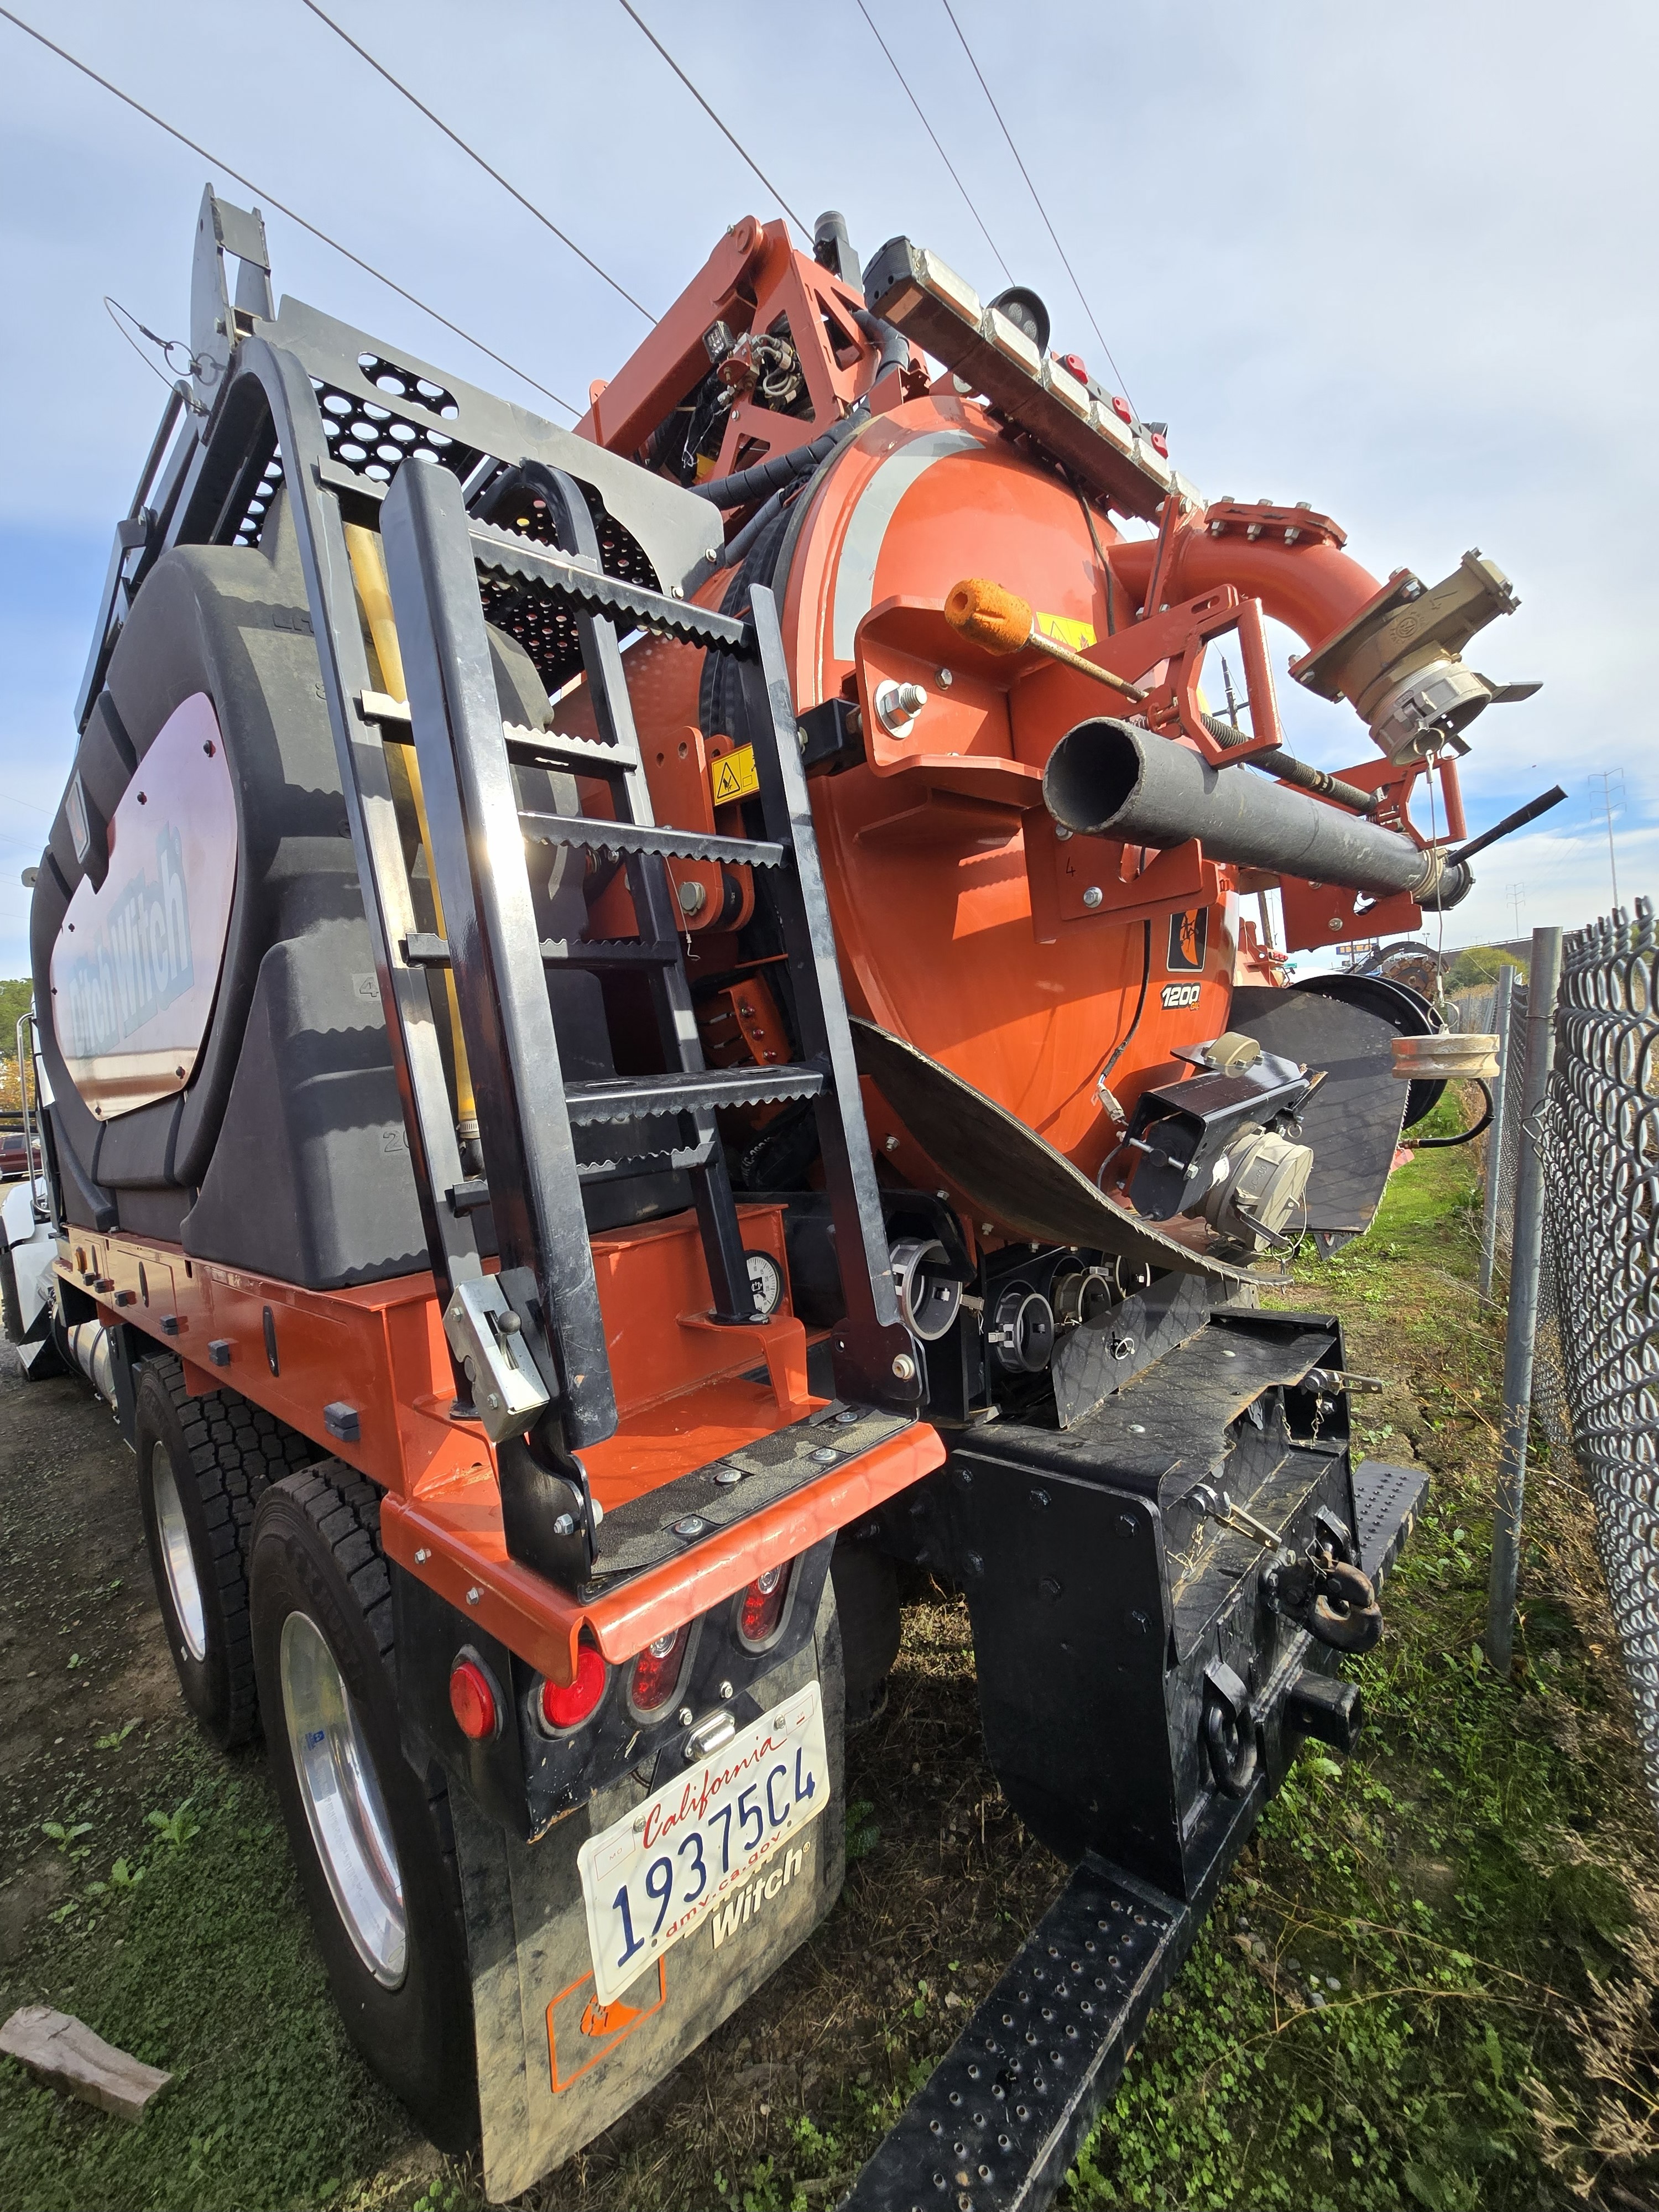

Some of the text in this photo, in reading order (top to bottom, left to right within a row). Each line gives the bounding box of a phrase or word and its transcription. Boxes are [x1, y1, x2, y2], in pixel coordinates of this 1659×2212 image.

[1066, 856, 1076, 877] 4
[111, 849, 189, 1022] Witch
[1161, 985, 1200, 1007] 1200
[1190, 1001, 1200, 1010] GAL
[1249, 1165, 1268, 1191] DC-600
[643, 1735, 787, 1849] California
[609, 1848, 623, 1860] MO
[612, 1746, 816, 1968] 19375C4
[665, 1830, 781, 1938] dmv.ca.gov
[712, 1848, 802, 1949] Witch
